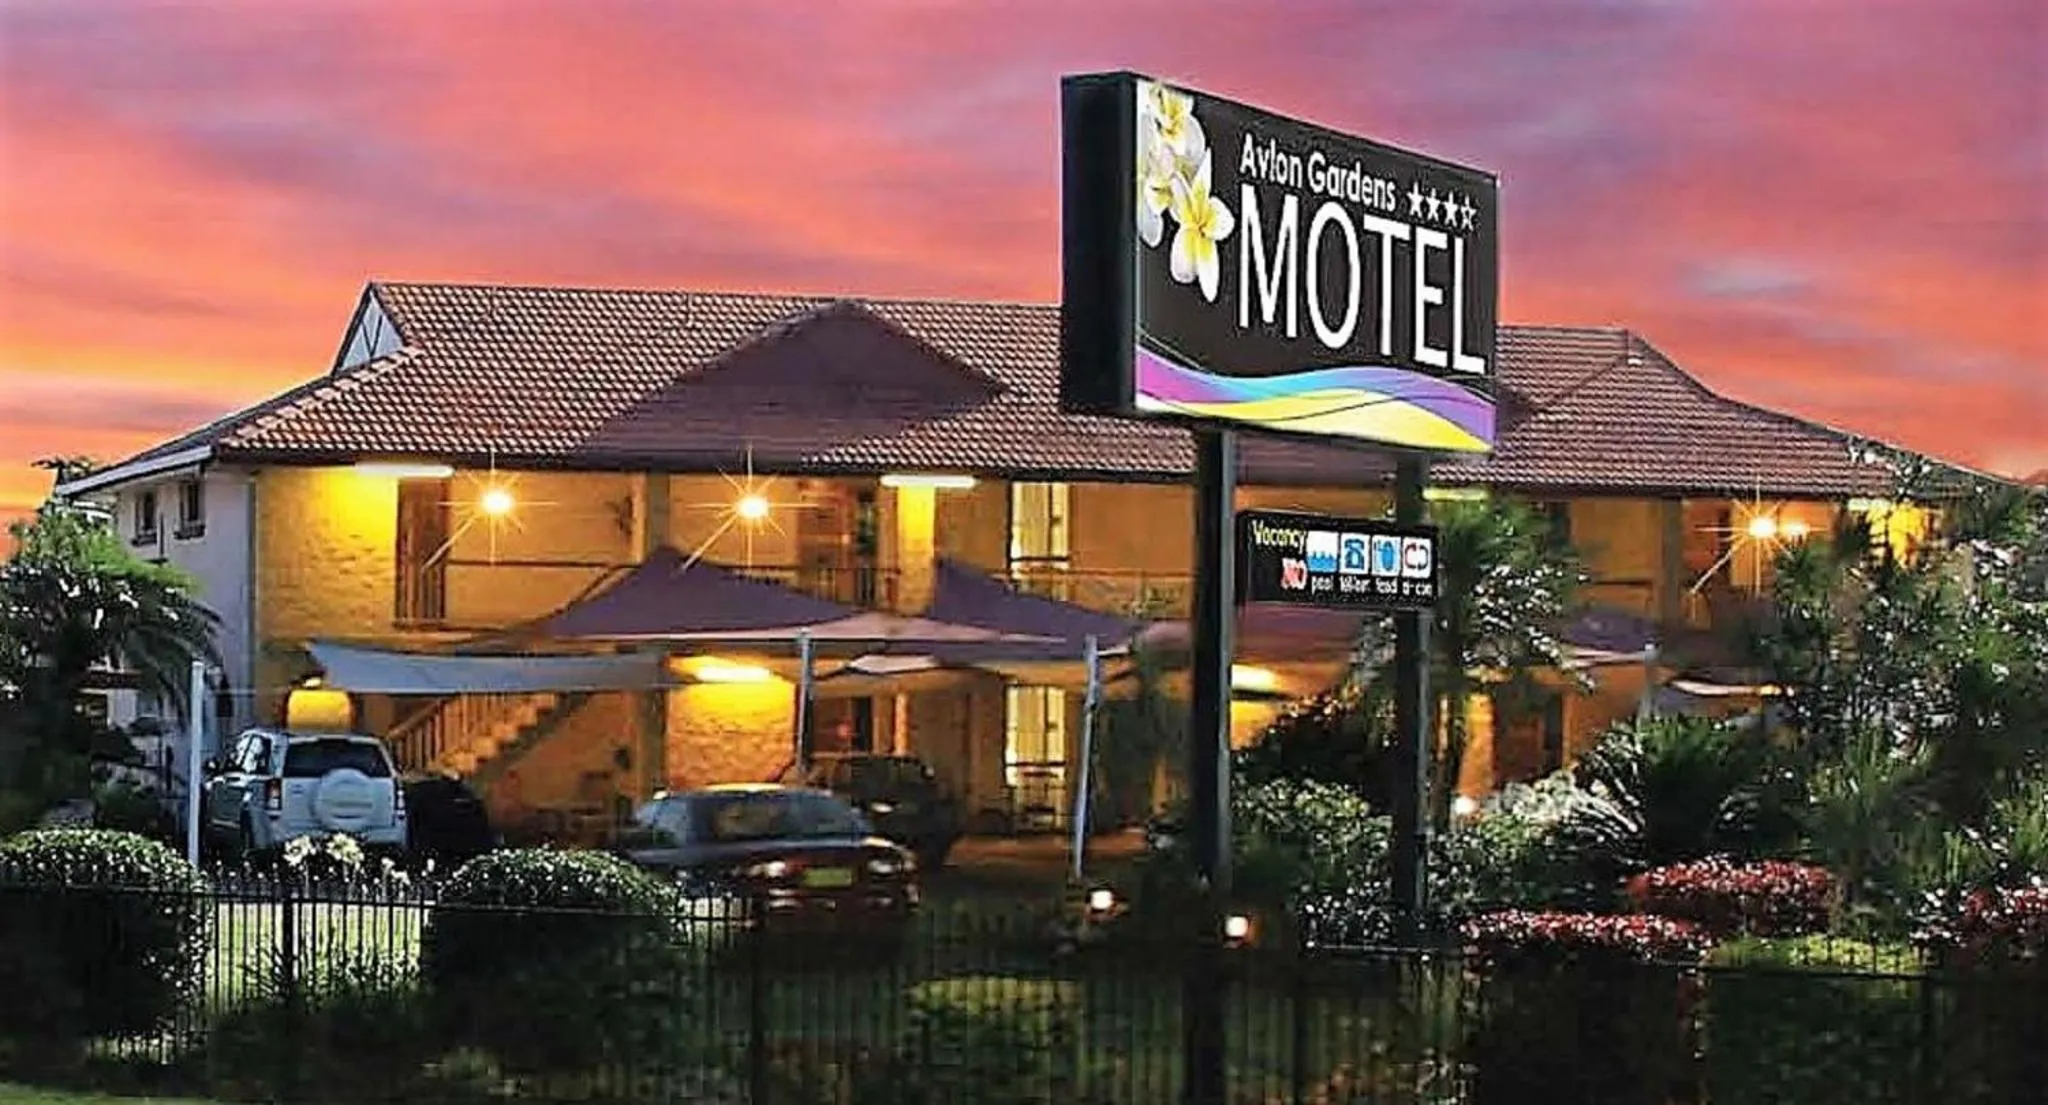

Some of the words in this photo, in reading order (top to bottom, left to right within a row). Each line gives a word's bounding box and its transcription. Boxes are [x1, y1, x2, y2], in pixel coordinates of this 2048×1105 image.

[1240, 133, 1302, 188] Avlon
[1308, 153, 1396, 212] Gardens
[1239, 184, 1486, 374] MOTEL
